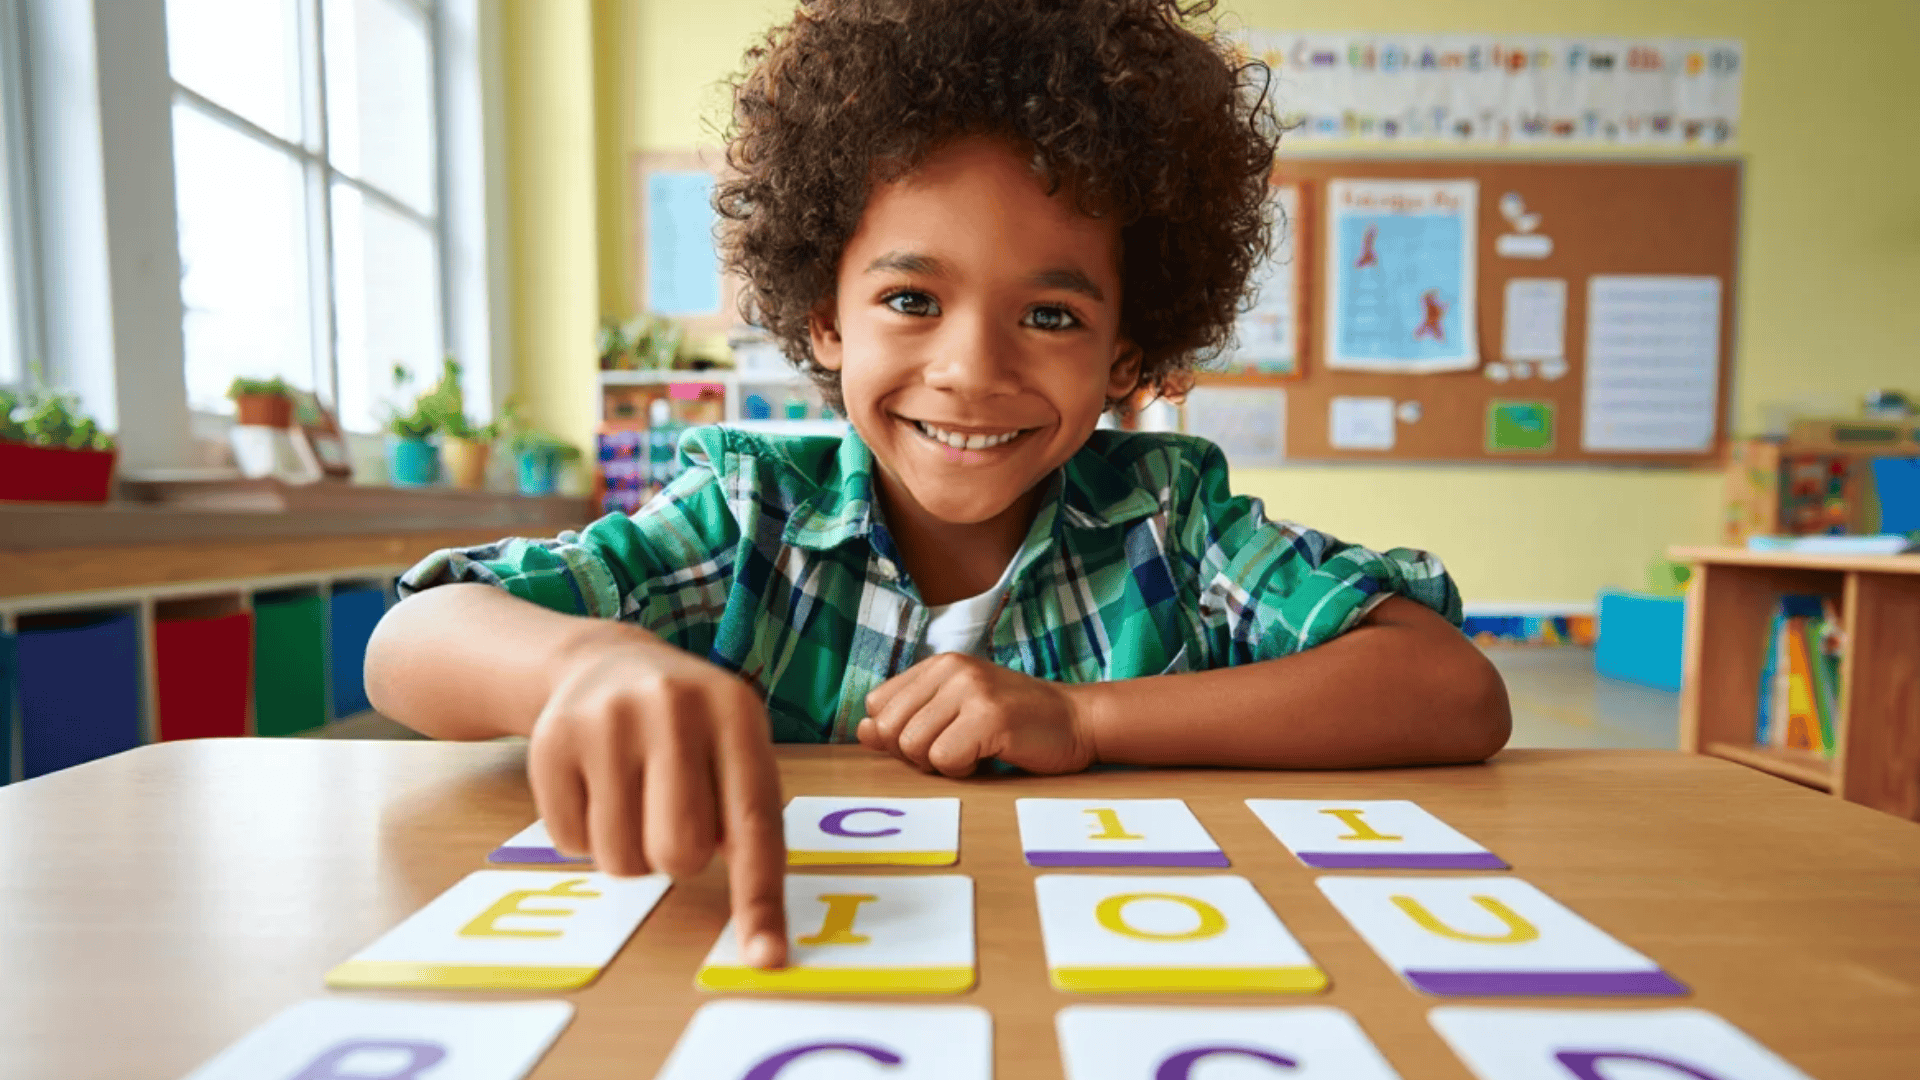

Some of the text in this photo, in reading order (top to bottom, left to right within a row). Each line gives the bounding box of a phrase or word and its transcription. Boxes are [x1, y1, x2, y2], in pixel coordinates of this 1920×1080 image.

[818, 807, 906, 838] C
[1318, 808, 1404, 841] I
[796, 893, 879, 946] I
[1095, 892, 1229, 943] O
[1389, 894, 1541, 944] U
